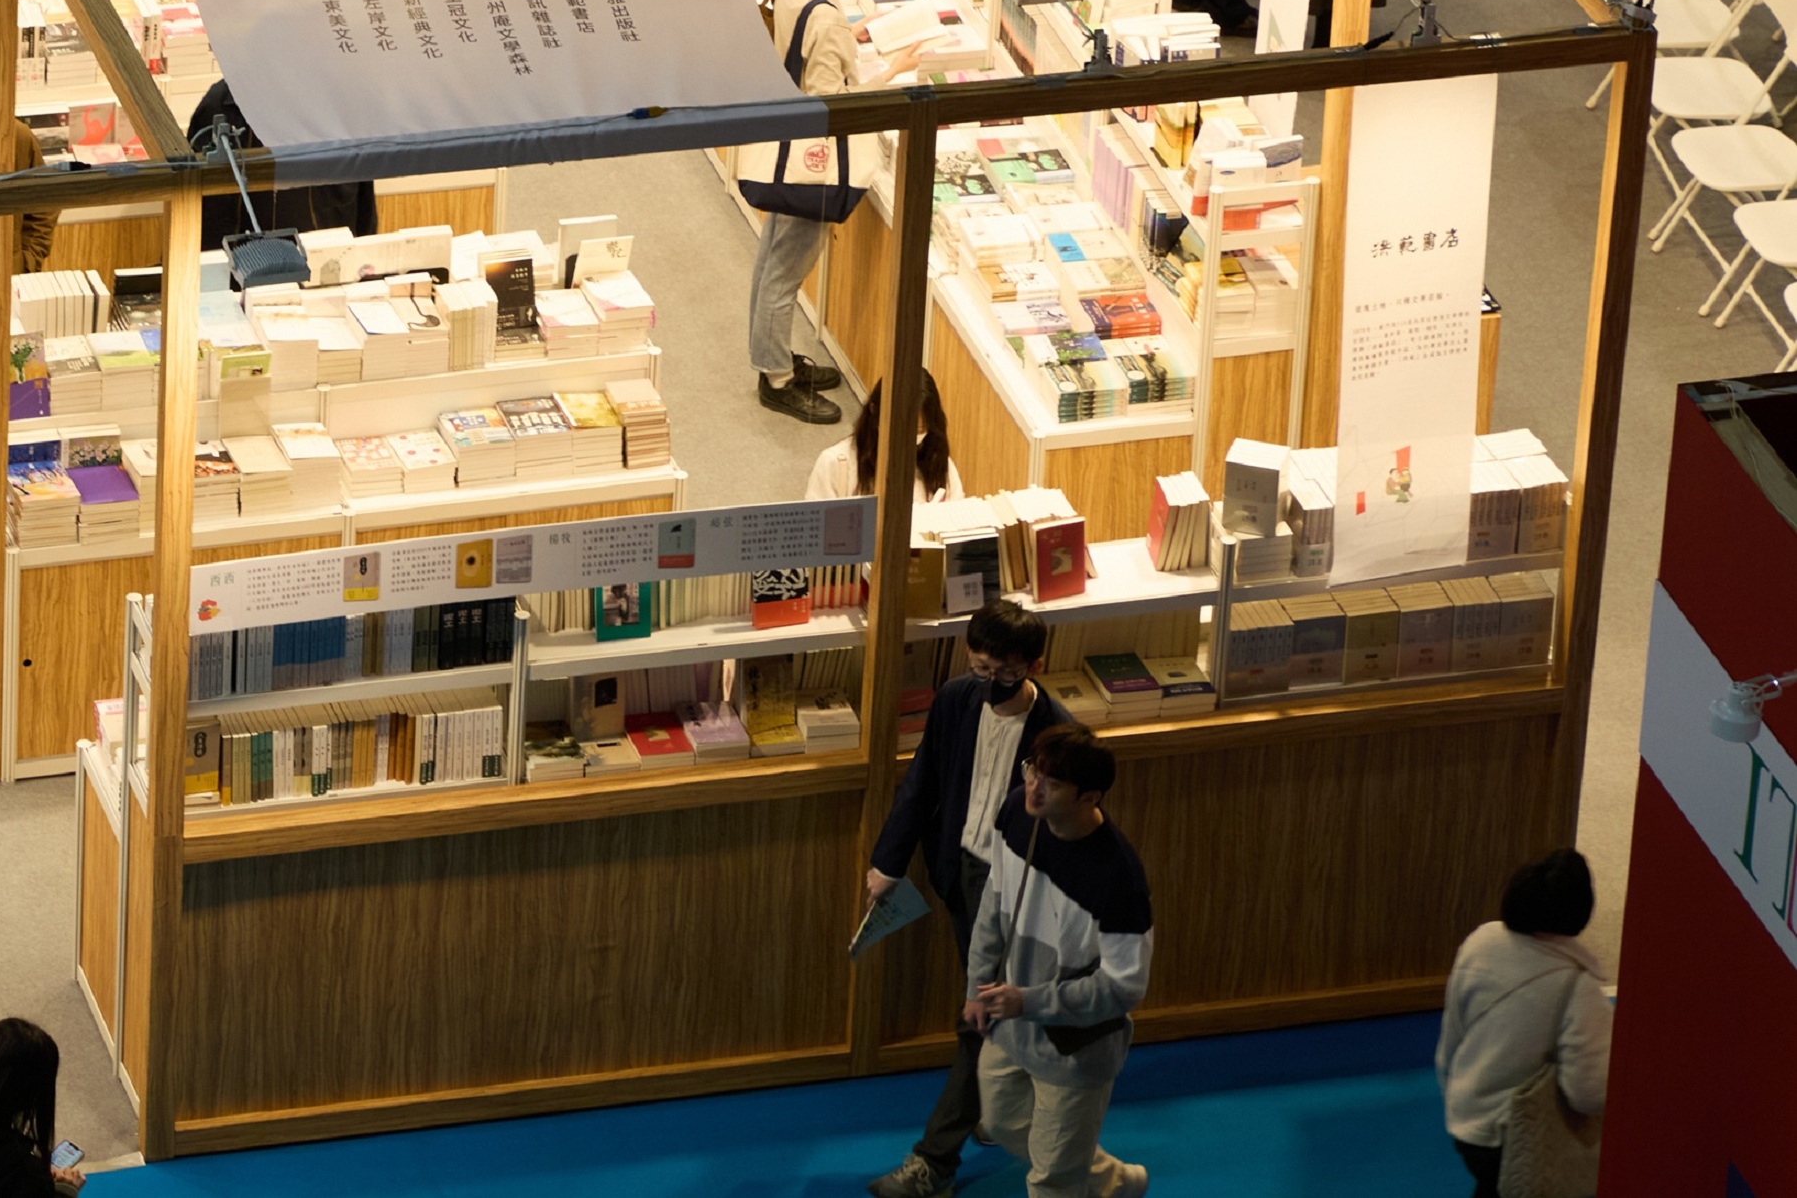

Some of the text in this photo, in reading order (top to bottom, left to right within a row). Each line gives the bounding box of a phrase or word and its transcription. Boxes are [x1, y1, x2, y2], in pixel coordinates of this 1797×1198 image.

[323, 0, 357, 54] 東美文化
[1372, 228, 1459, 258] 洪範書店
[210, 572, 235, 587] 西西
